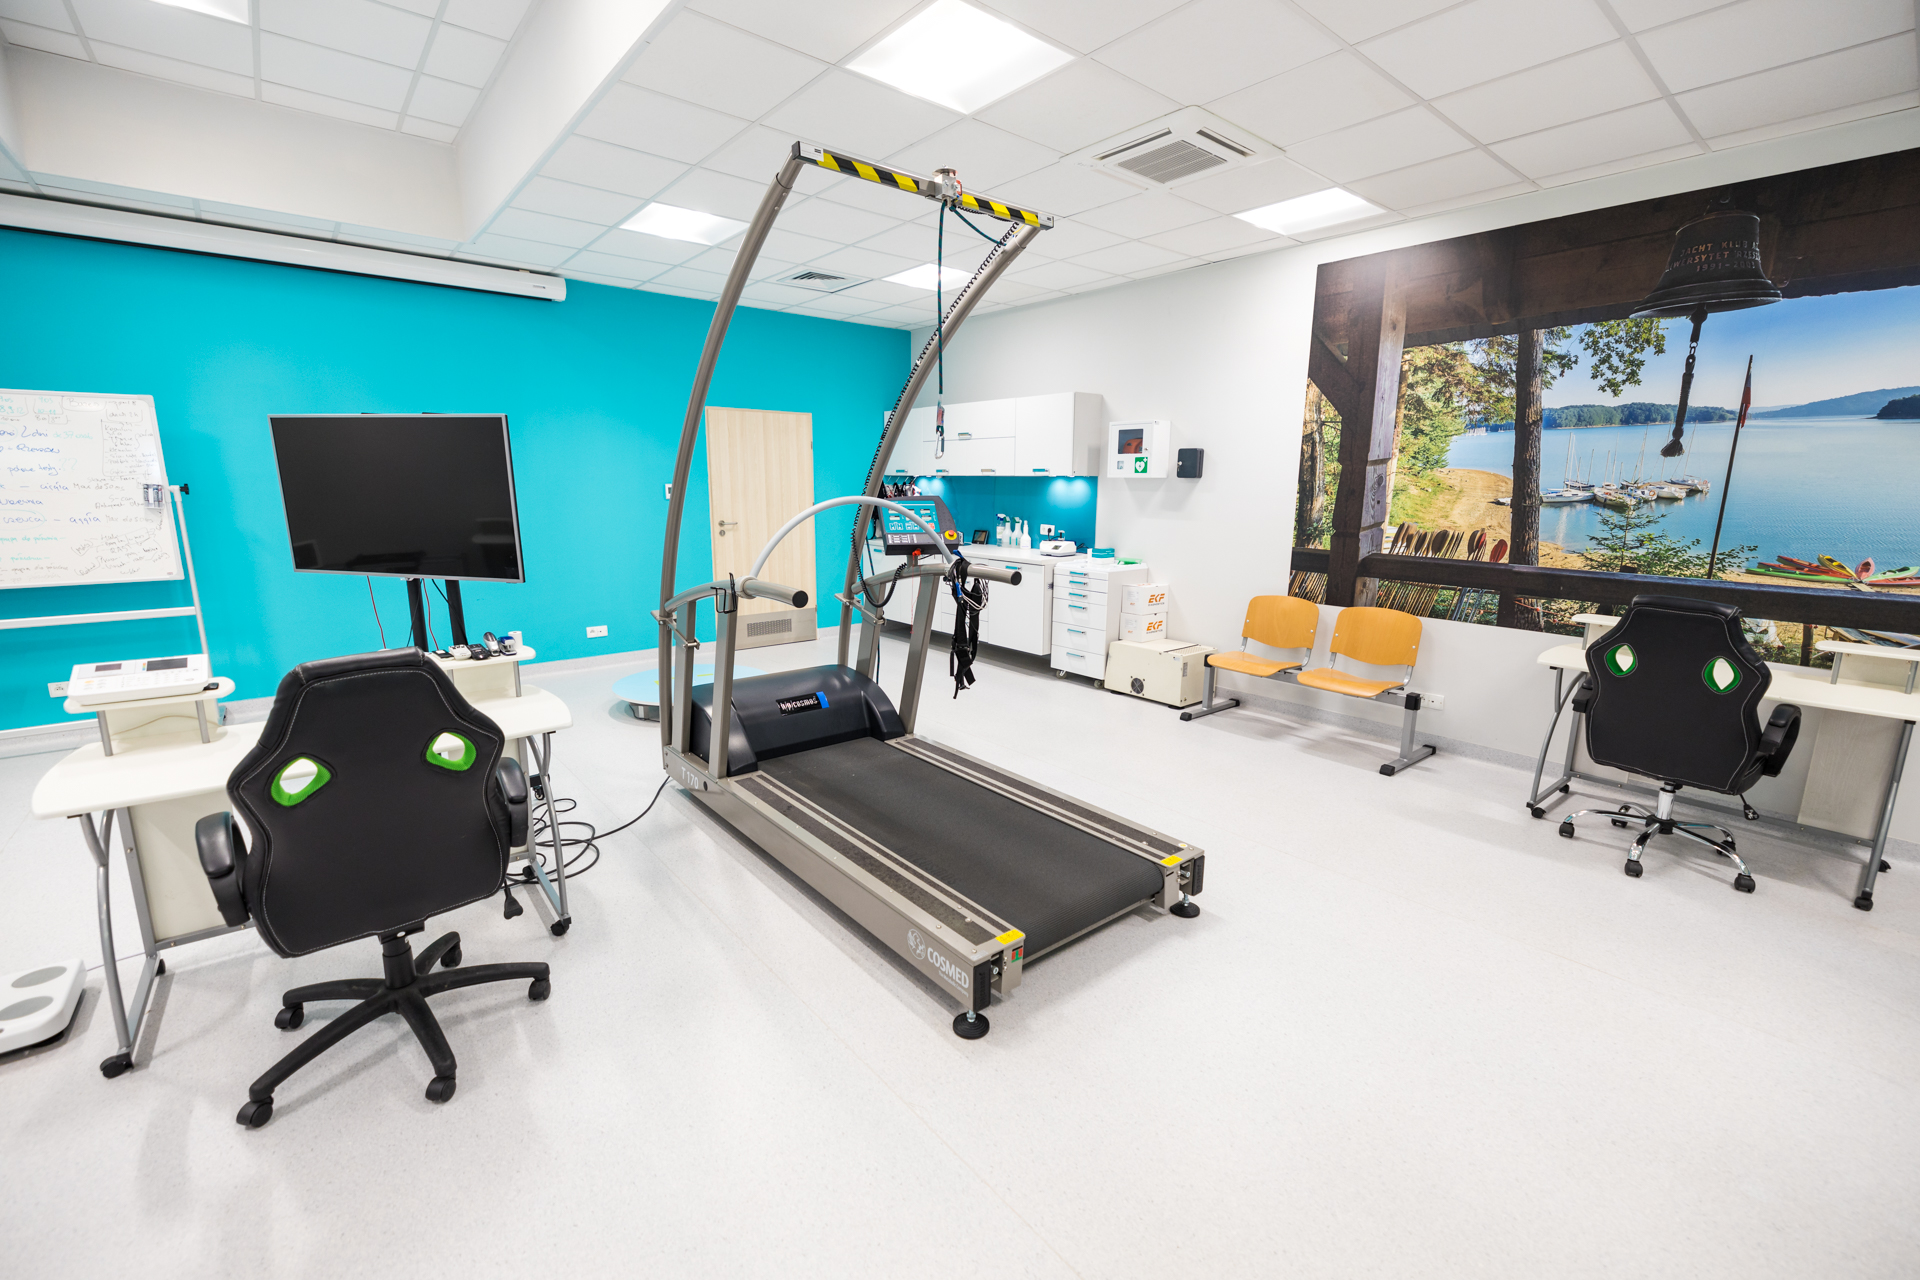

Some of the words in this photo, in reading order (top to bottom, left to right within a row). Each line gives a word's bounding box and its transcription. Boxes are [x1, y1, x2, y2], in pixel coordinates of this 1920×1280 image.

[1681, 243, 1713, 256] JACHT
[1721, 240, 1748, 249] KLUB
[1148, 593, 1165, 603] EKF
[1146, 620, 1163, 631] EKF
[927, 947, 969, 988] COSMED
